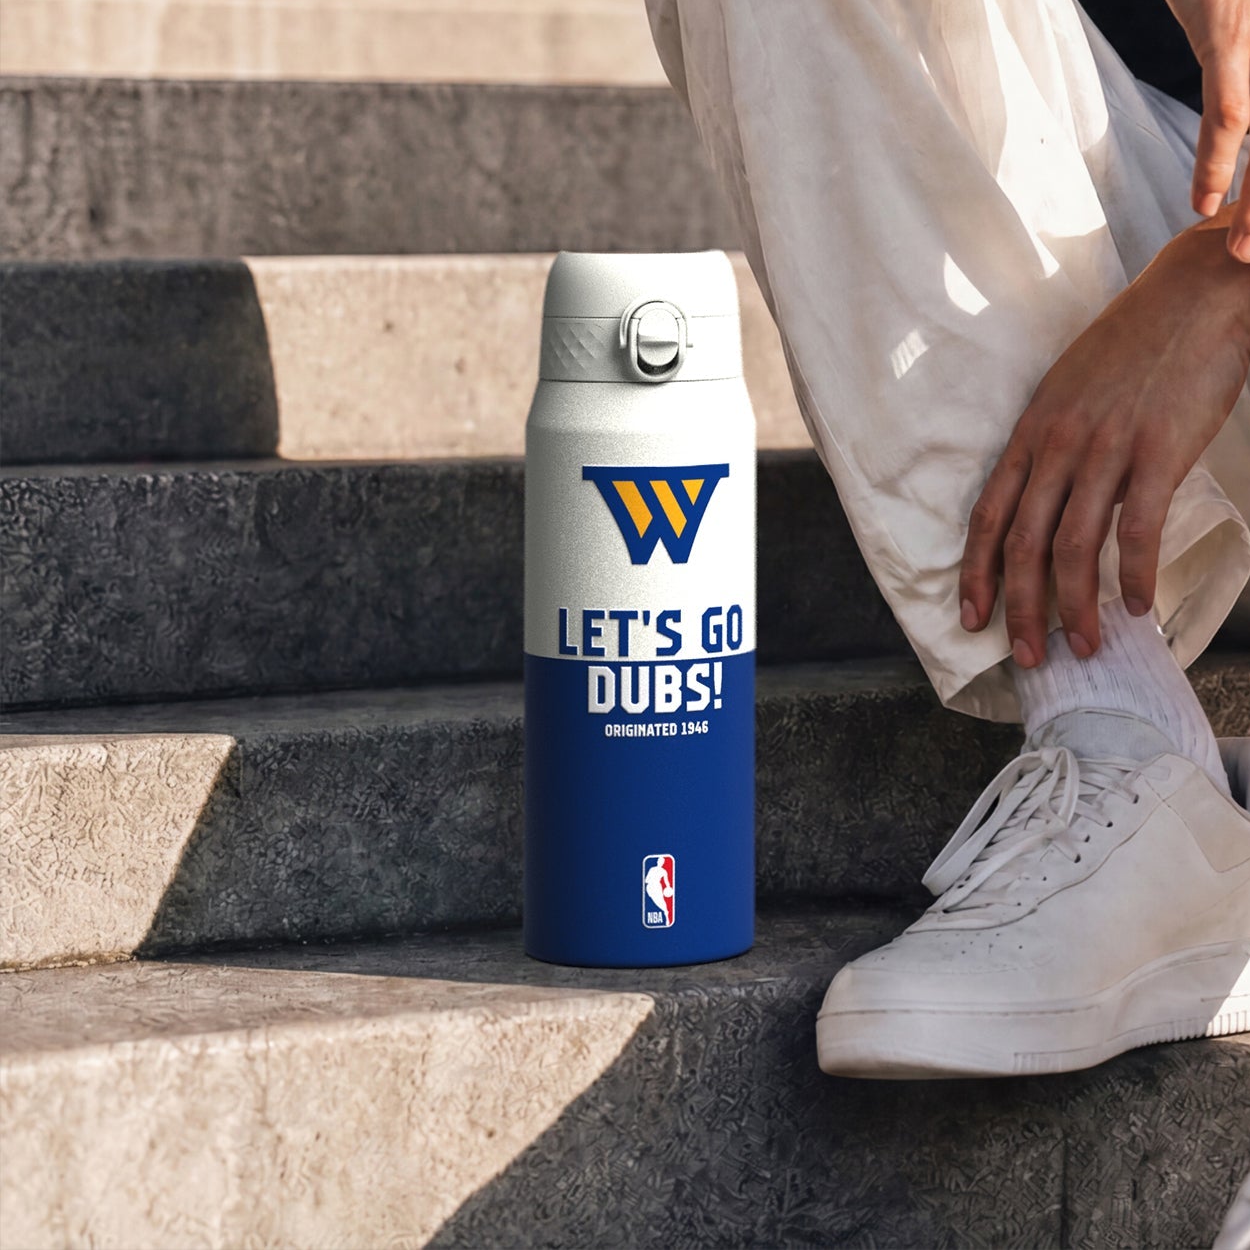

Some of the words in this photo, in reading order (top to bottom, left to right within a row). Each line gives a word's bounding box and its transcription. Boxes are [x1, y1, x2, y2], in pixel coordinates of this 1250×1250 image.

[582, 463, 729, 565] W
[559, 607, 682, 657] LET'S
[702, 604, 743, 653] GO
[588, 661, 723, 714] DUBS!
[605, 723, 678, 737] ORIGINATED
[681, 720, 709, 736] 1946
[647, 911, 663, 924] NBA
